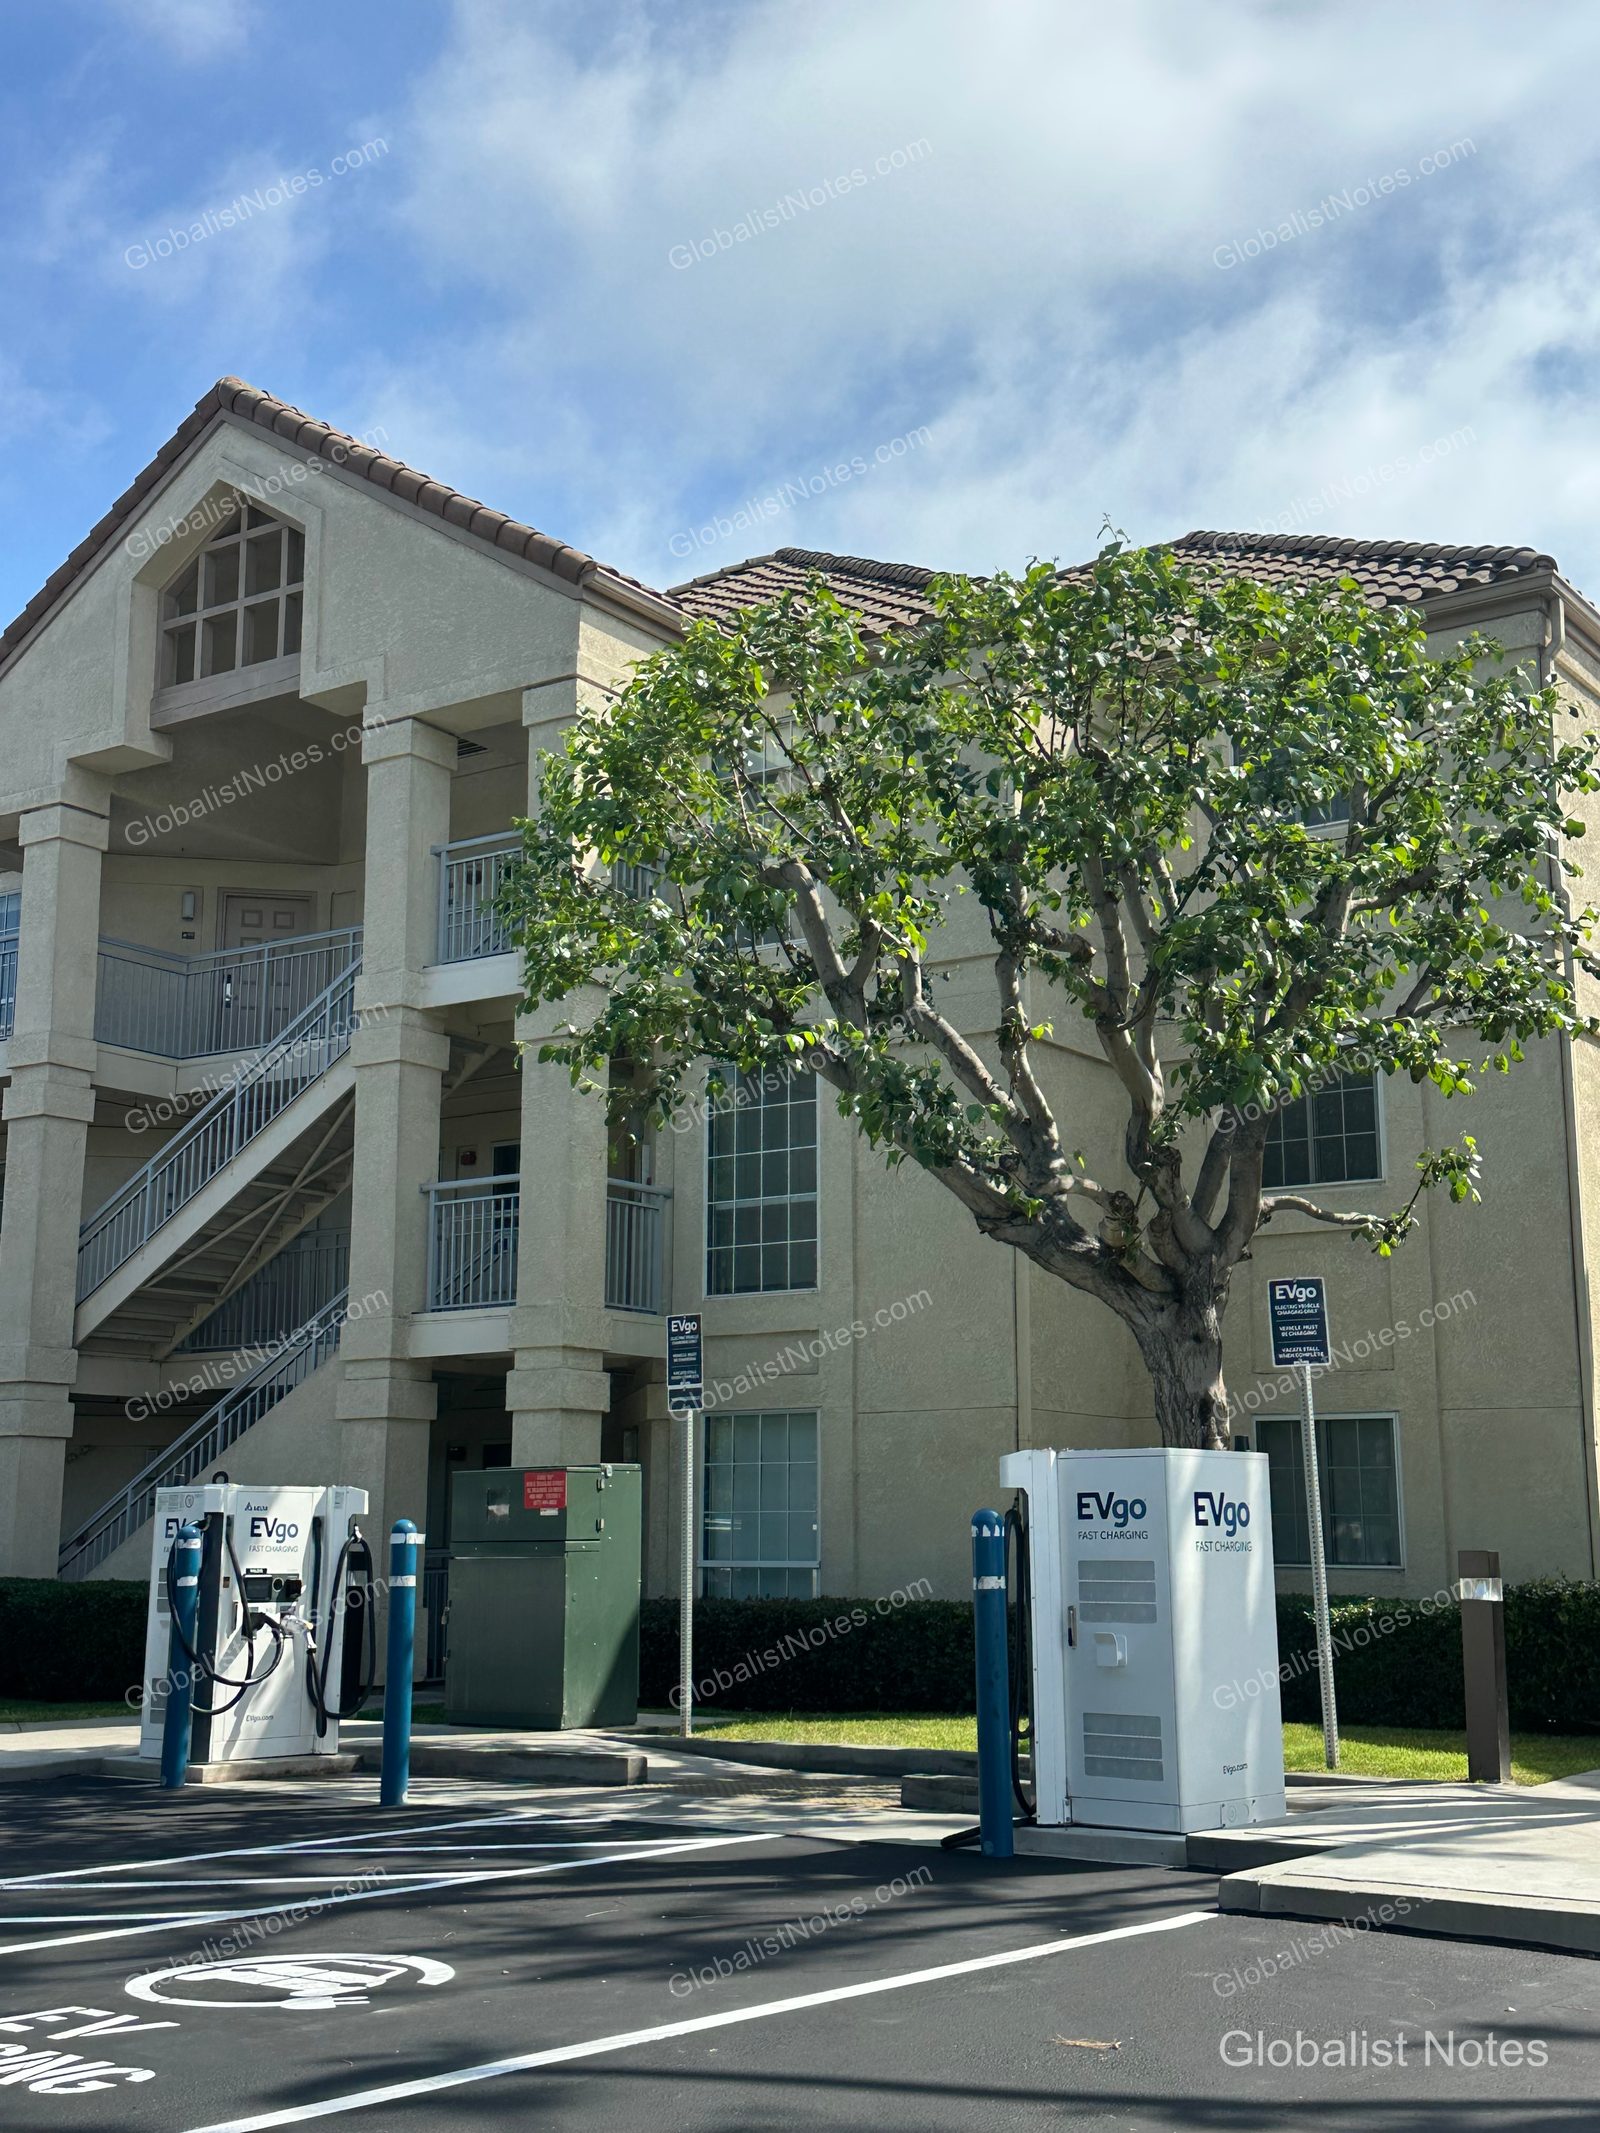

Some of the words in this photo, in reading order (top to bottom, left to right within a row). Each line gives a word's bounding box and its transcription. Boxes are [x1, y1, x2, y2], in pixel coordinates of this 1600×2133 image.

[1275, 1284, 1317, 1302] EVgo
[671, 1319, 697, 1334] EVgo
[1077, 1492, 1147, 1527] EVgo
[1194, 1492, 1250, 1537] EVgo
[251, 1517, 299, 1544] EVgo
[1078, 1531, 1098, 1540] FAST
[1100, 1531, 1148, 1540] CHARGING
[1196, 1541, 1213, 1552] FAST
[1214, 1541, 1253, 1552] CHARGING
[1222, 1763, 1248, 1775] EVgo.com
[0, 2006, 181, 2040] EV
[0, 2044, 156, 2094] ING
